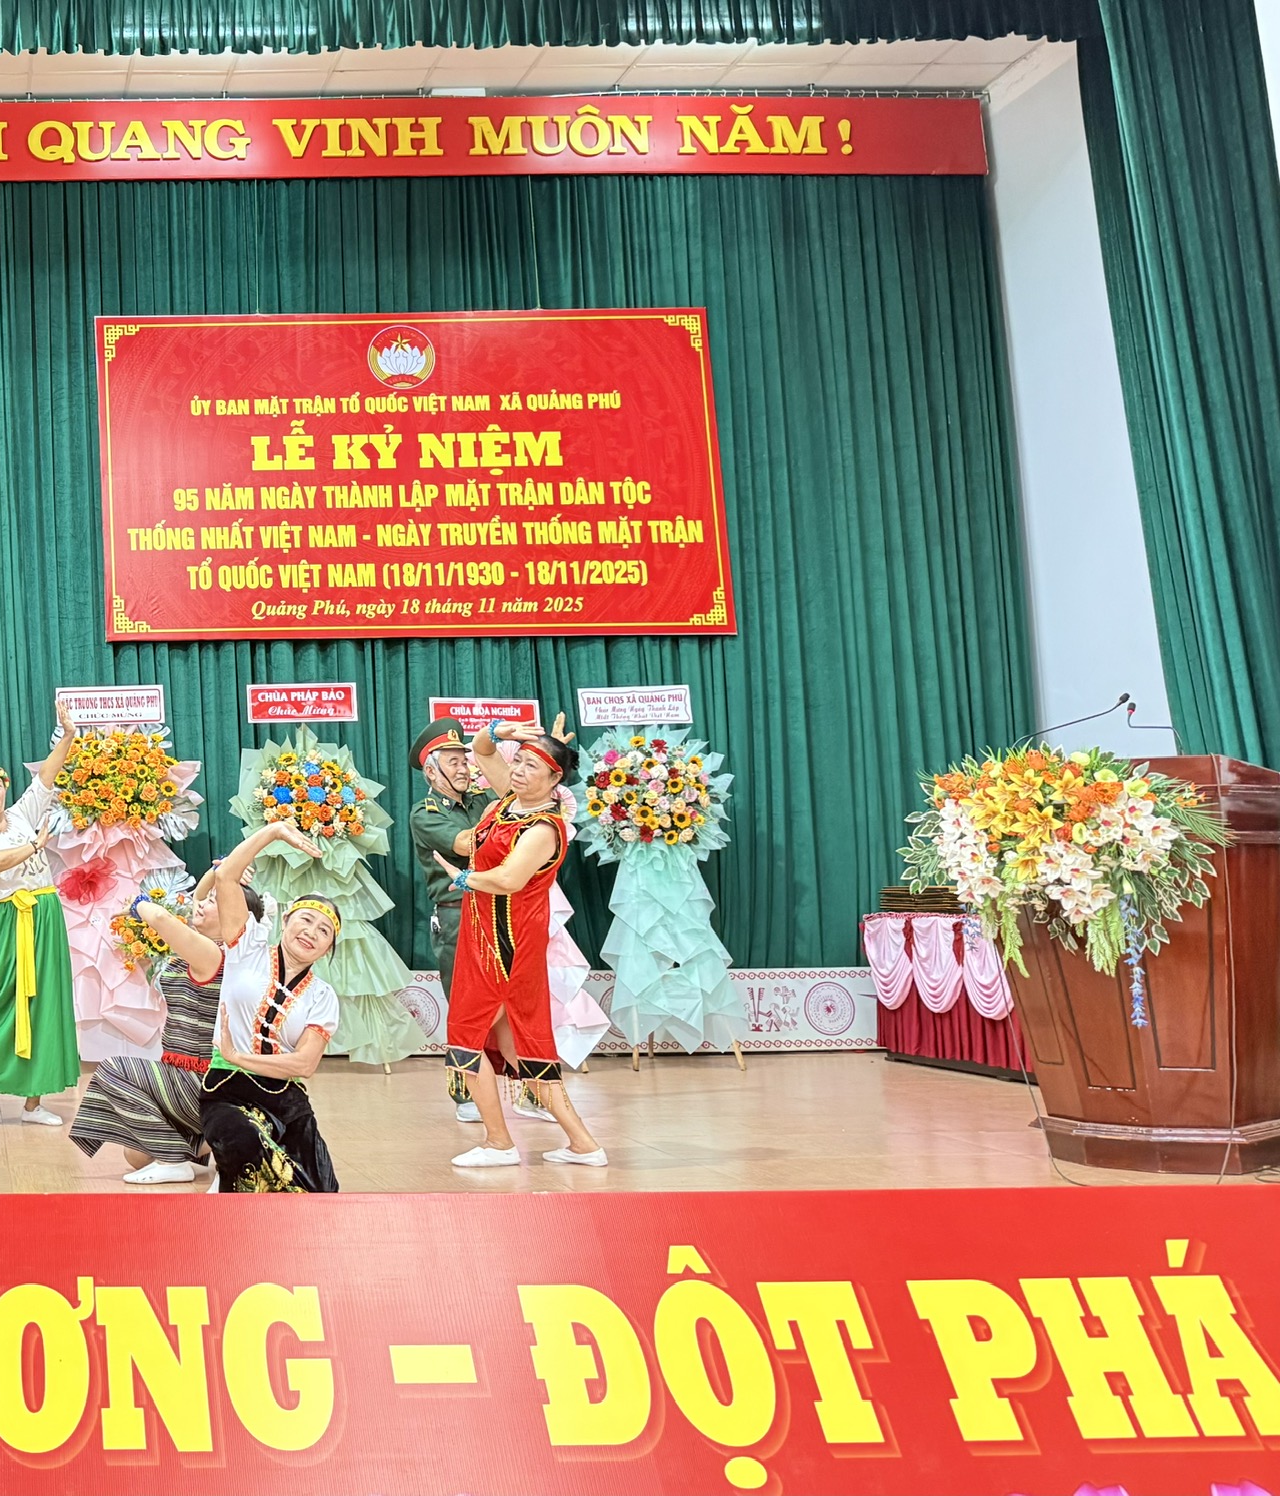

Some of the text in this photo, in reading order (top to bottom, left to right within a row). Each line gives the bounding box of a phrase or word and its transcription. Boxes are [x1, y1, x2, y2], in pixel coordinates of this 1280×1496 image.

[28, 118, 251, 163] QUANG
[272, 117, 443, 157] VINH
[469, 104, 653, 155] MUÔN
[676, 104, 827, 153] NĂM
[191, 389, 621, 417] ỦY BAN MẶT TRẬN TỔ QUỐC VIỆT NAM XÃ QUẢNG PHÚ
[251, 420, 563, 475] LỄ KỶ NIỆM
[173, 477, 651, 512] 95 NĂM NGÀY THÀNH LẬP MẶT TRẬN DÂN TỘC
[127, 520, 195, 552] THỐNG
[200, 518, 254, 550] NHẤT
[259, 521, 302, 553] VIỆT
[308, 525, 356, 548] NAM
[377, 519, 431, 547] NGÀY
[437, 515, 517, 546] TRUYỀN
[522, 514, 592, 544] THỐNG
[598, 516, 642, 548] MẶT
[648, 516, 703, 548] TRẬN
[186, 557, 212, 590] TỔ
[218, 557, 273, 592] QUỐC
[278, 560, 322, 593] VIỆT
[328, 564, 376, 587] NAM
[383, 562, 504, 589] (18/11/1930
[525, 560, 648, 586] 18/11/2025)
[252, 597, 583, 620] Quảng Phú, ngày 18 tháng 11 năm 2025
[258, 688, 344, 702] CHÙA PHÁP BẢO
[268, 705, 335, 716] Chúc Mừng
[450, 705, 471, 715] CHÙA
[517, 1246, 883, 1488] ĐỘT
[907, 1240, 1280, 1440] PHÁ
